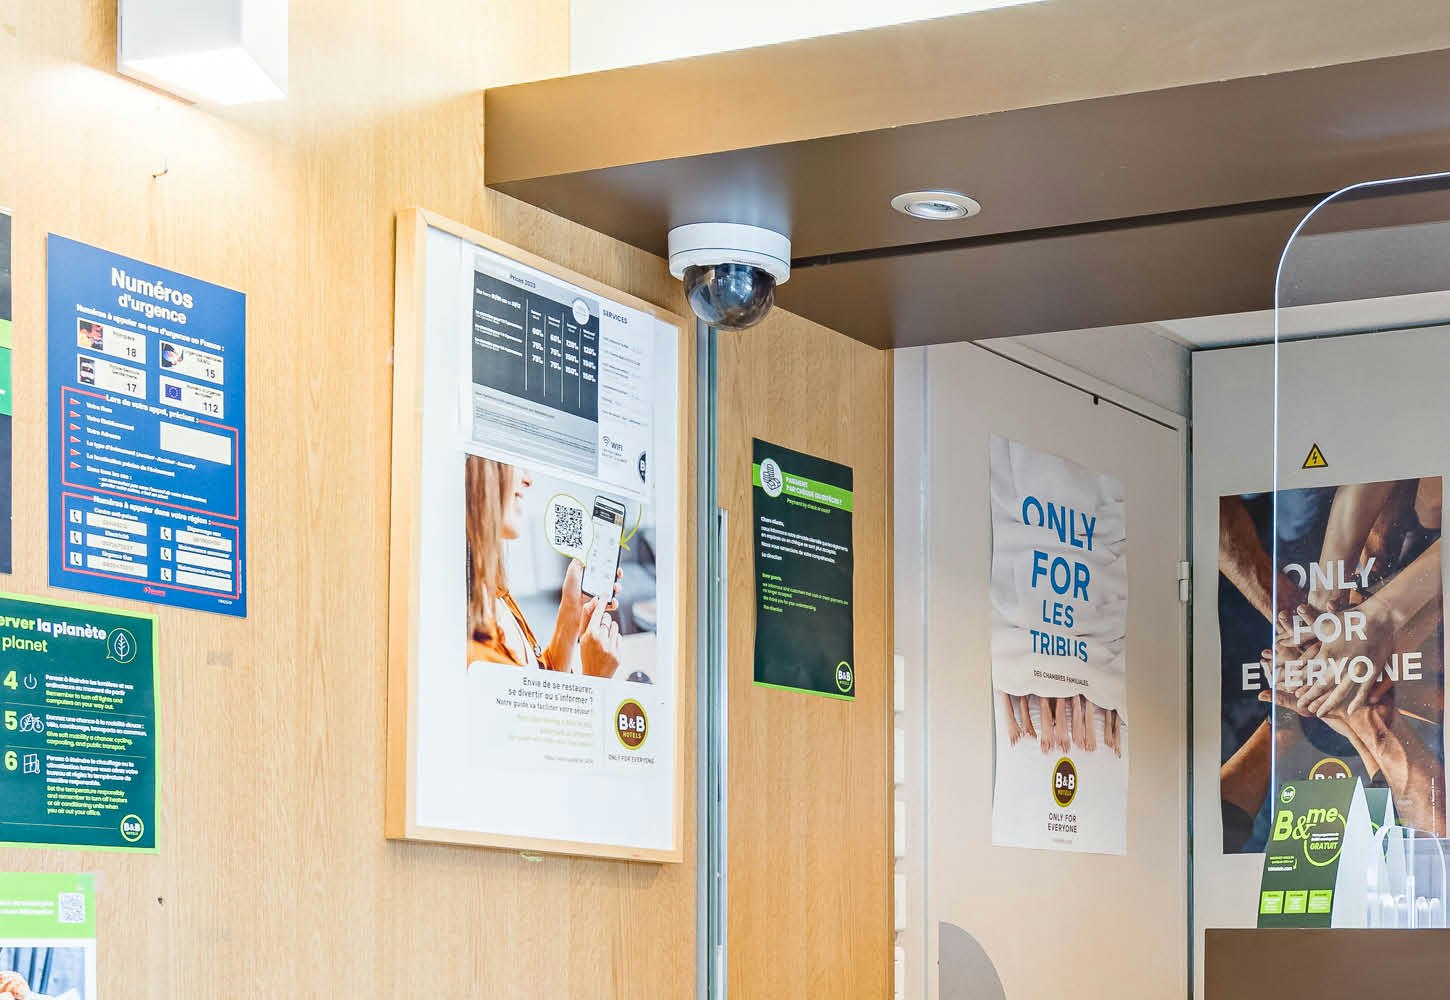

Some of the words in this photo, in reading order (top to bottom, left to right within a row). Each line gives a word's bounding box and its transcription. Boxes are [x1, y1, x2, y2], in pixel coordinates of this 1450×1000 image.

[111, 268, 193, 308] Numéros
[118, 294, 187, 324] d'urgence
[603, 309, 628, 325] SERVICES
[126, 347, 137, 357] 18
[205, 369, 215, 379] 15
[127, 383, 137, 393] 17
[204, 402, 218, 413] 112
[1022, 495, 1097, 551] ONLY
[1031, 550, 1090, 601] FOR
[1282, 556, 1377, 593] ONLY
[1042, 599, 1074, 628] LES
[37, 618, 51, 632] la
[53, 622, 106, 640] planète
[1293, 610, 1368, 646] FOR
[2, 636, 48, 652] planet
[4, 670, 18, 690] 4
[838, 670, 850, 681] B&B
[1034, 669, 1042, 677] DES
[1043, 671, 1066, 682] CHAMBRES
[1240, 651, 1424, 692] EVERYONE
[523, 677, 541, 687] Envie
[543, 680, 551, 688] de
[562, 683, 593, 694] restaurer,
[508, 688, 516, 696] se
[518, 688, 543, 699] divertir
[545, 693, 553, 701] ou
[555, 693, 587, 705] s'informer
[496, 698, 512, 707] Notre
[513, 700, 529, 709] guide
[537, 701, 558, 712] faciliter
[559, 704, 573, 713] votre
[4, 710, 17, 730] 5
[618, 713, 645, 732] B&B
[622, 731, 642, 739] HOTELS
[4, 750, 17, 771] 6
[631, 755, 655, 764] EVERYONE
[1055, 772, 1075, 789] B&B
[1049, 812, 1063, 821] ONLY
[1065, 814, 1077, 823] FOR
[123, 822, 140, 832] B&B
[1047, 823, 1077, 833] EVERYONE
[1309, 841, 1337, 850] GRATUIT
